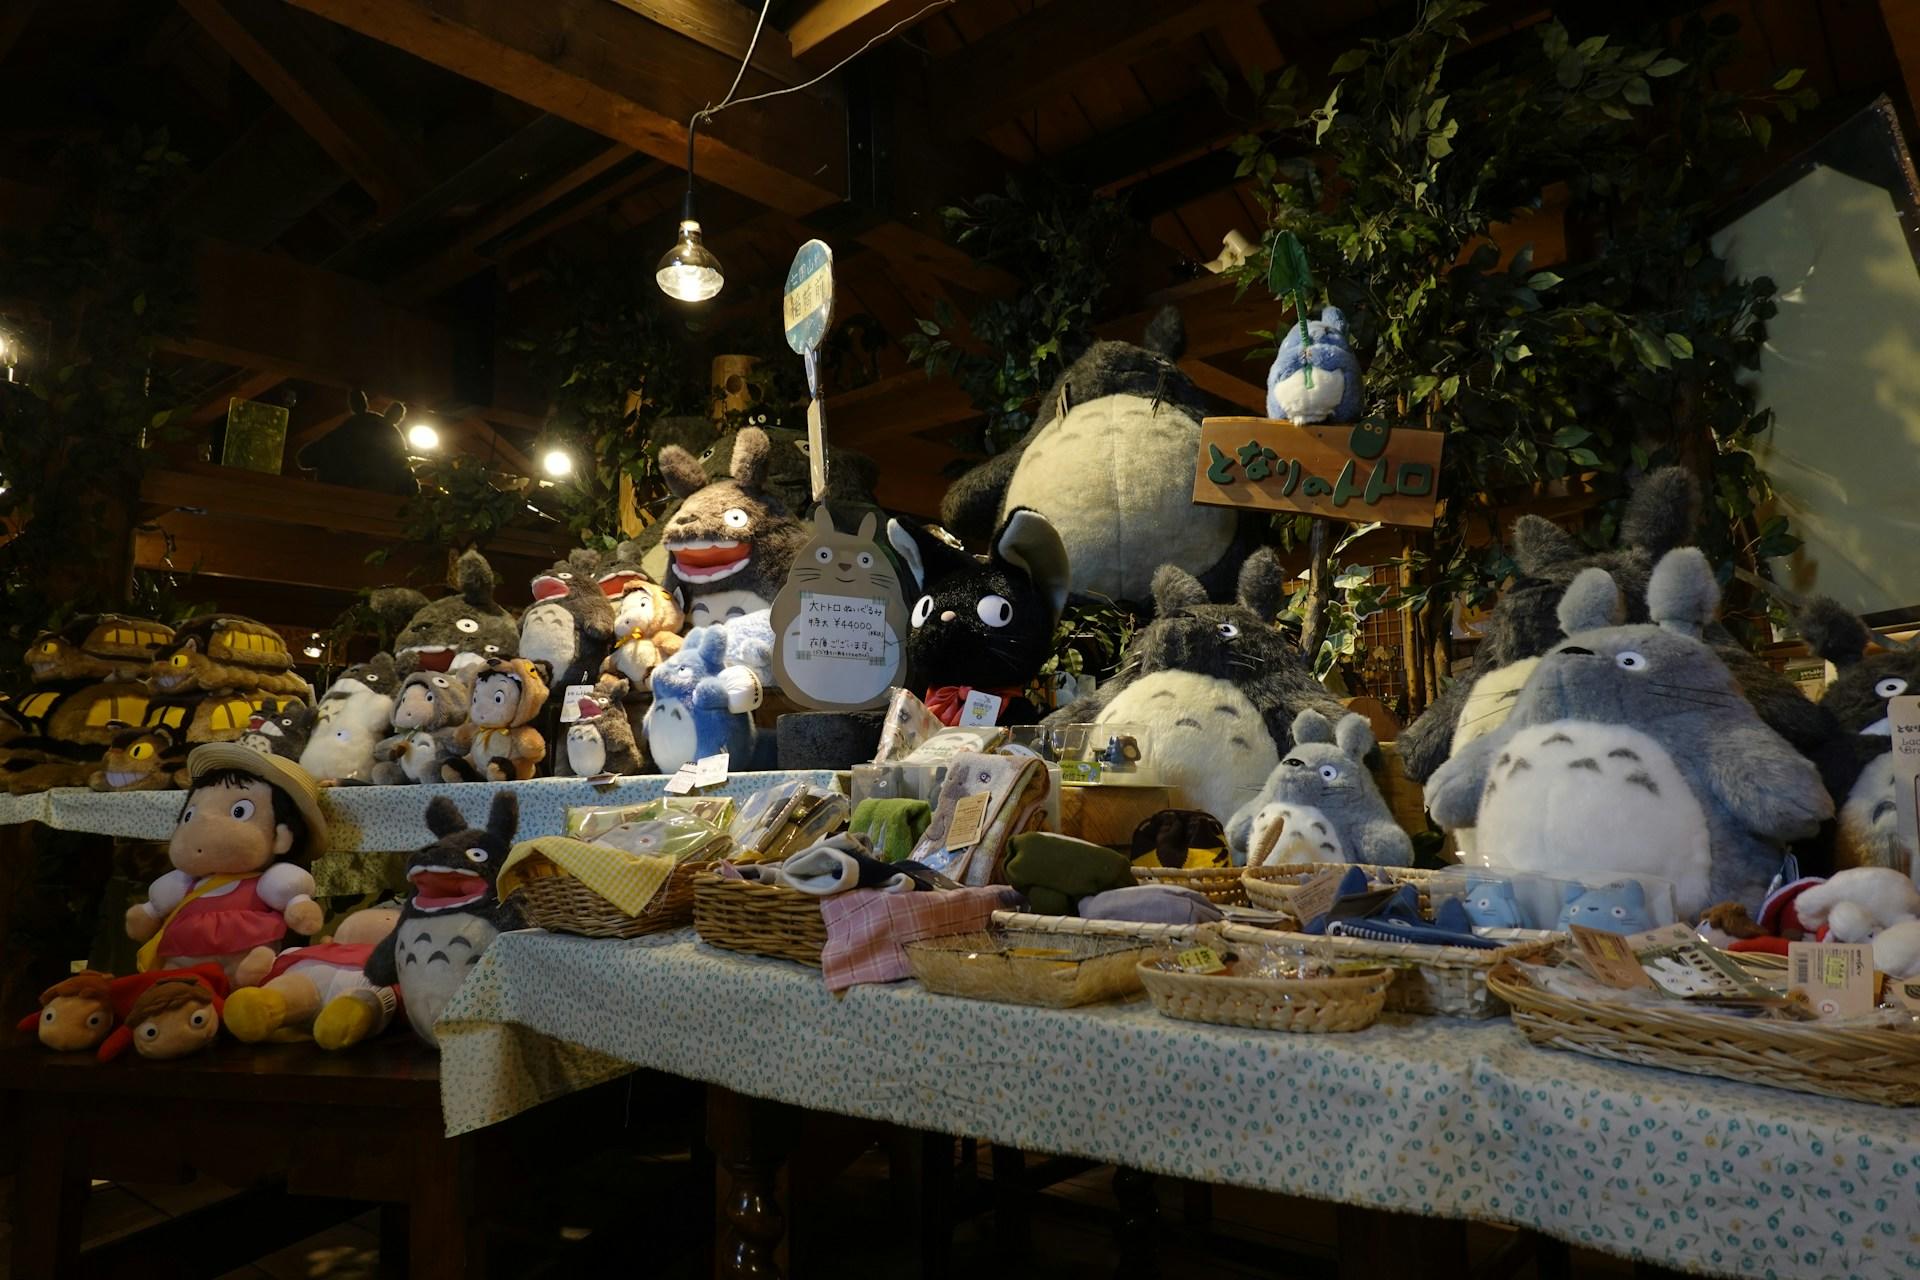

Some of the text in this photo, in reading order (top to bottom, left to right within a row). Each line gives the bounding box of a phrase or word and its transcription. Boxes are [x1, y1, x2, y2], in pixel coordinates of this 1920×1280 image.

[1207, 440, 1433, 507] となりのトトロ
